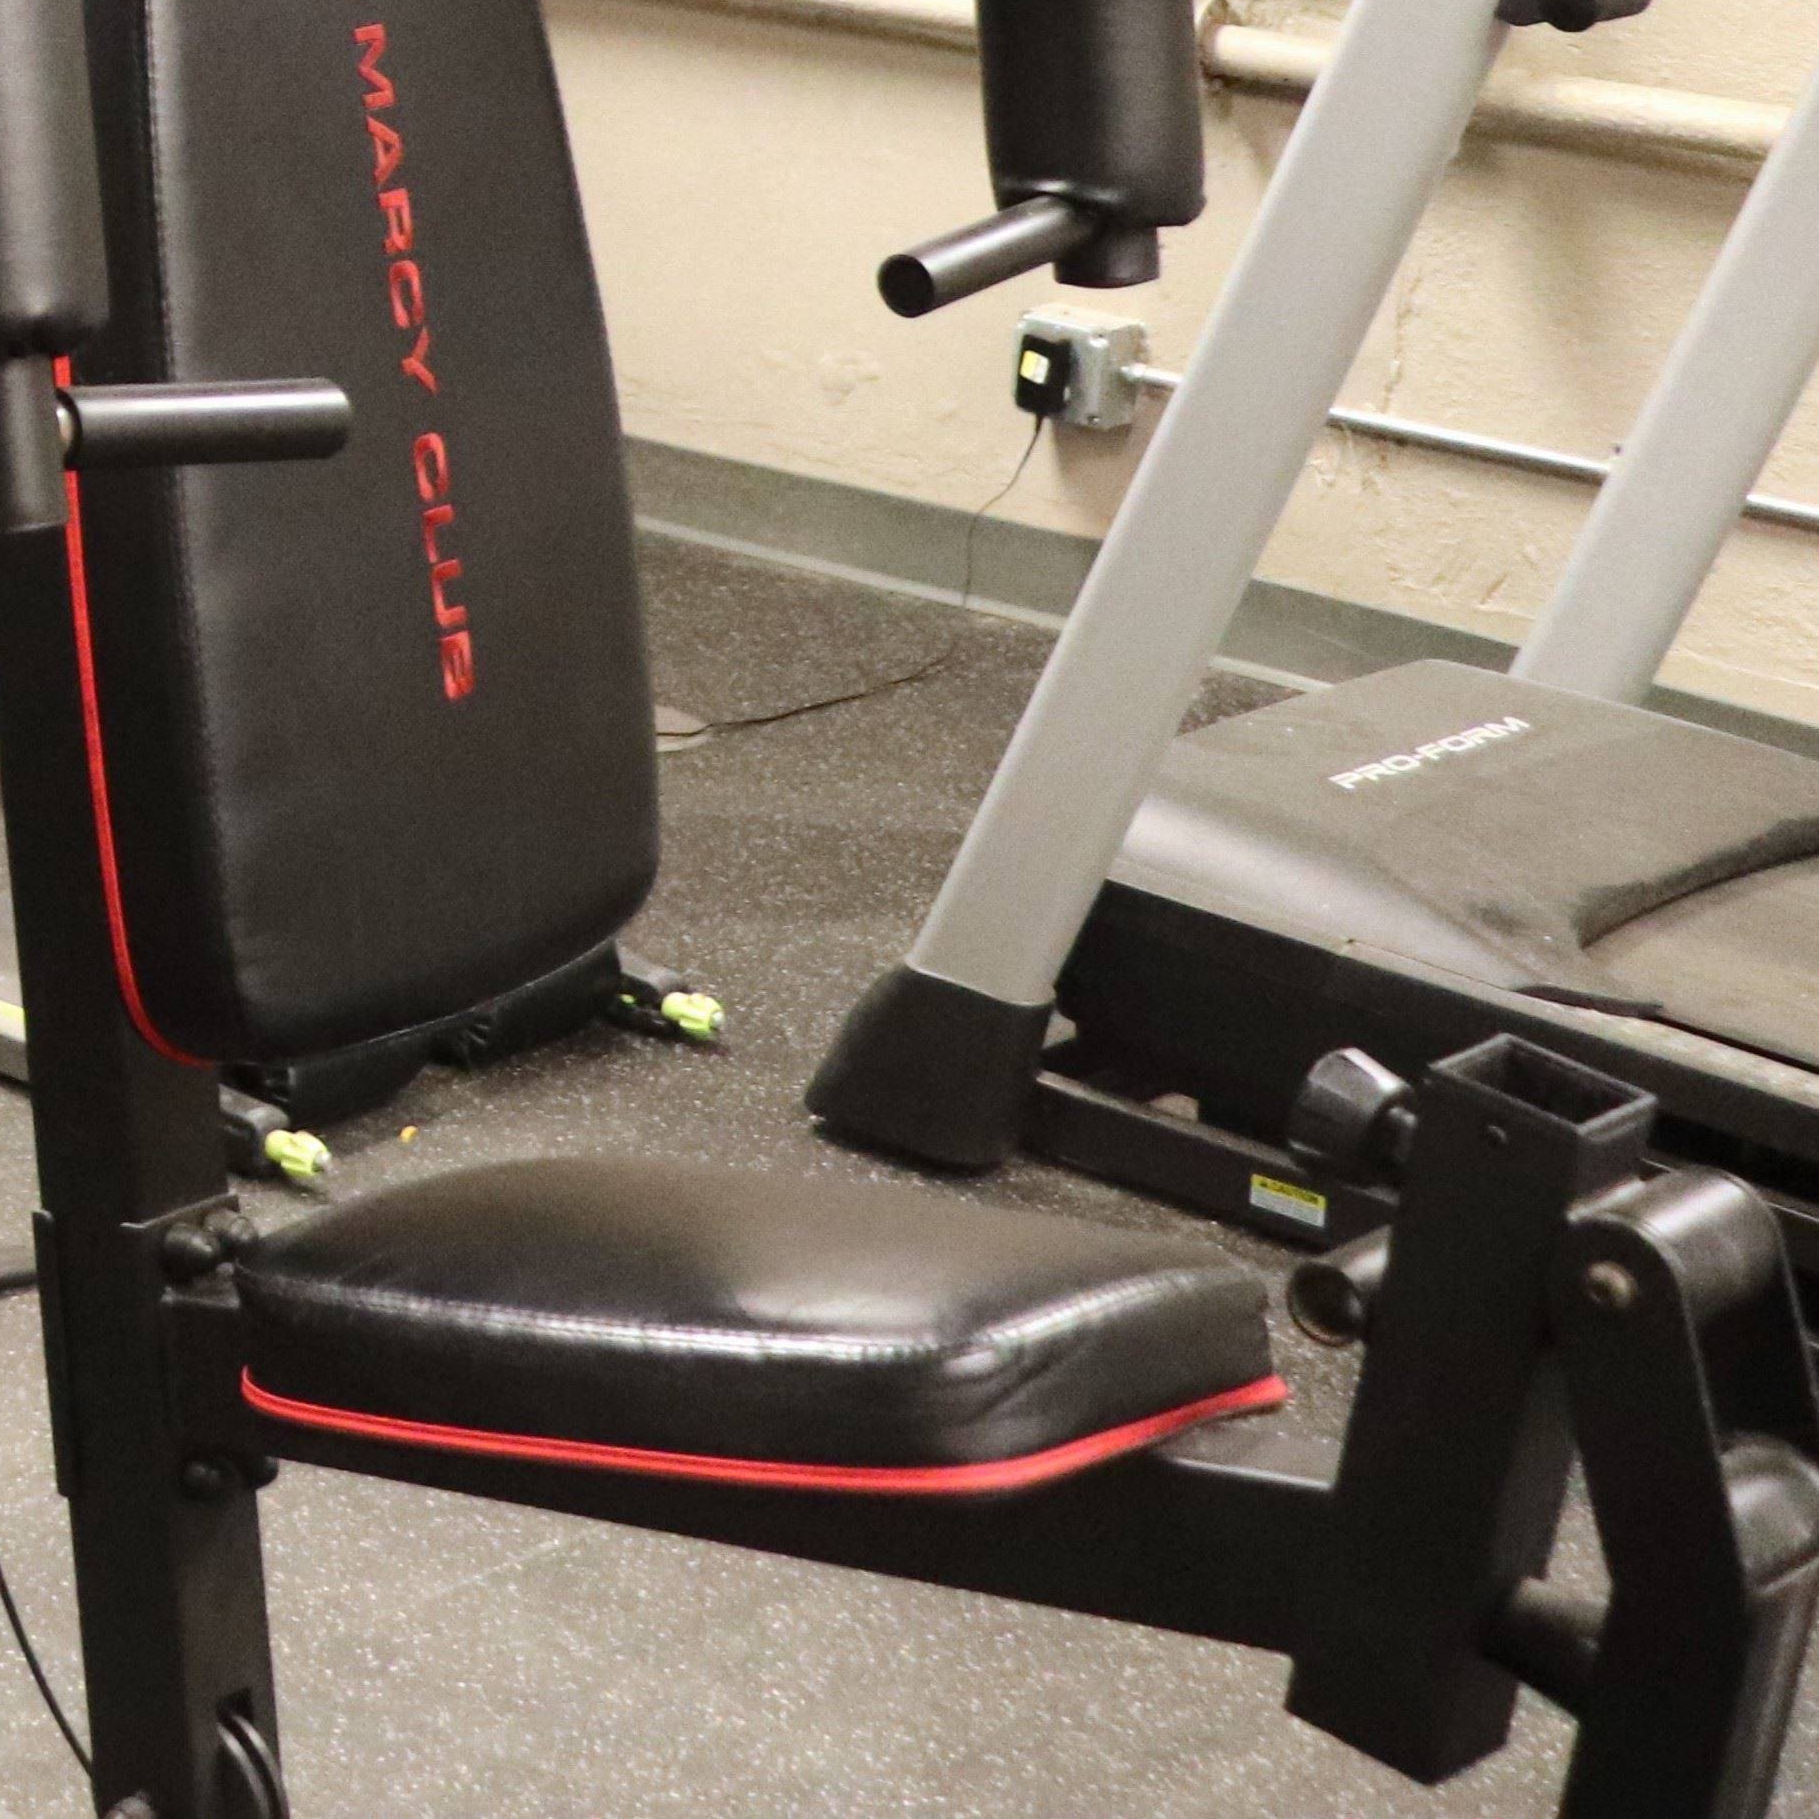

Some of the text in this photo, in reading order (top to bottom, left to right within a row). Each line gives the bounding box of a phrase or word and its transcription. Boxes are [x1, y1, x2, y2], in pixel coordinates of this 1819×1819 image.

[353, 22, 476, 701] MARCY CLUB
[1327, 715, 1531, 790] PRO-FORM
